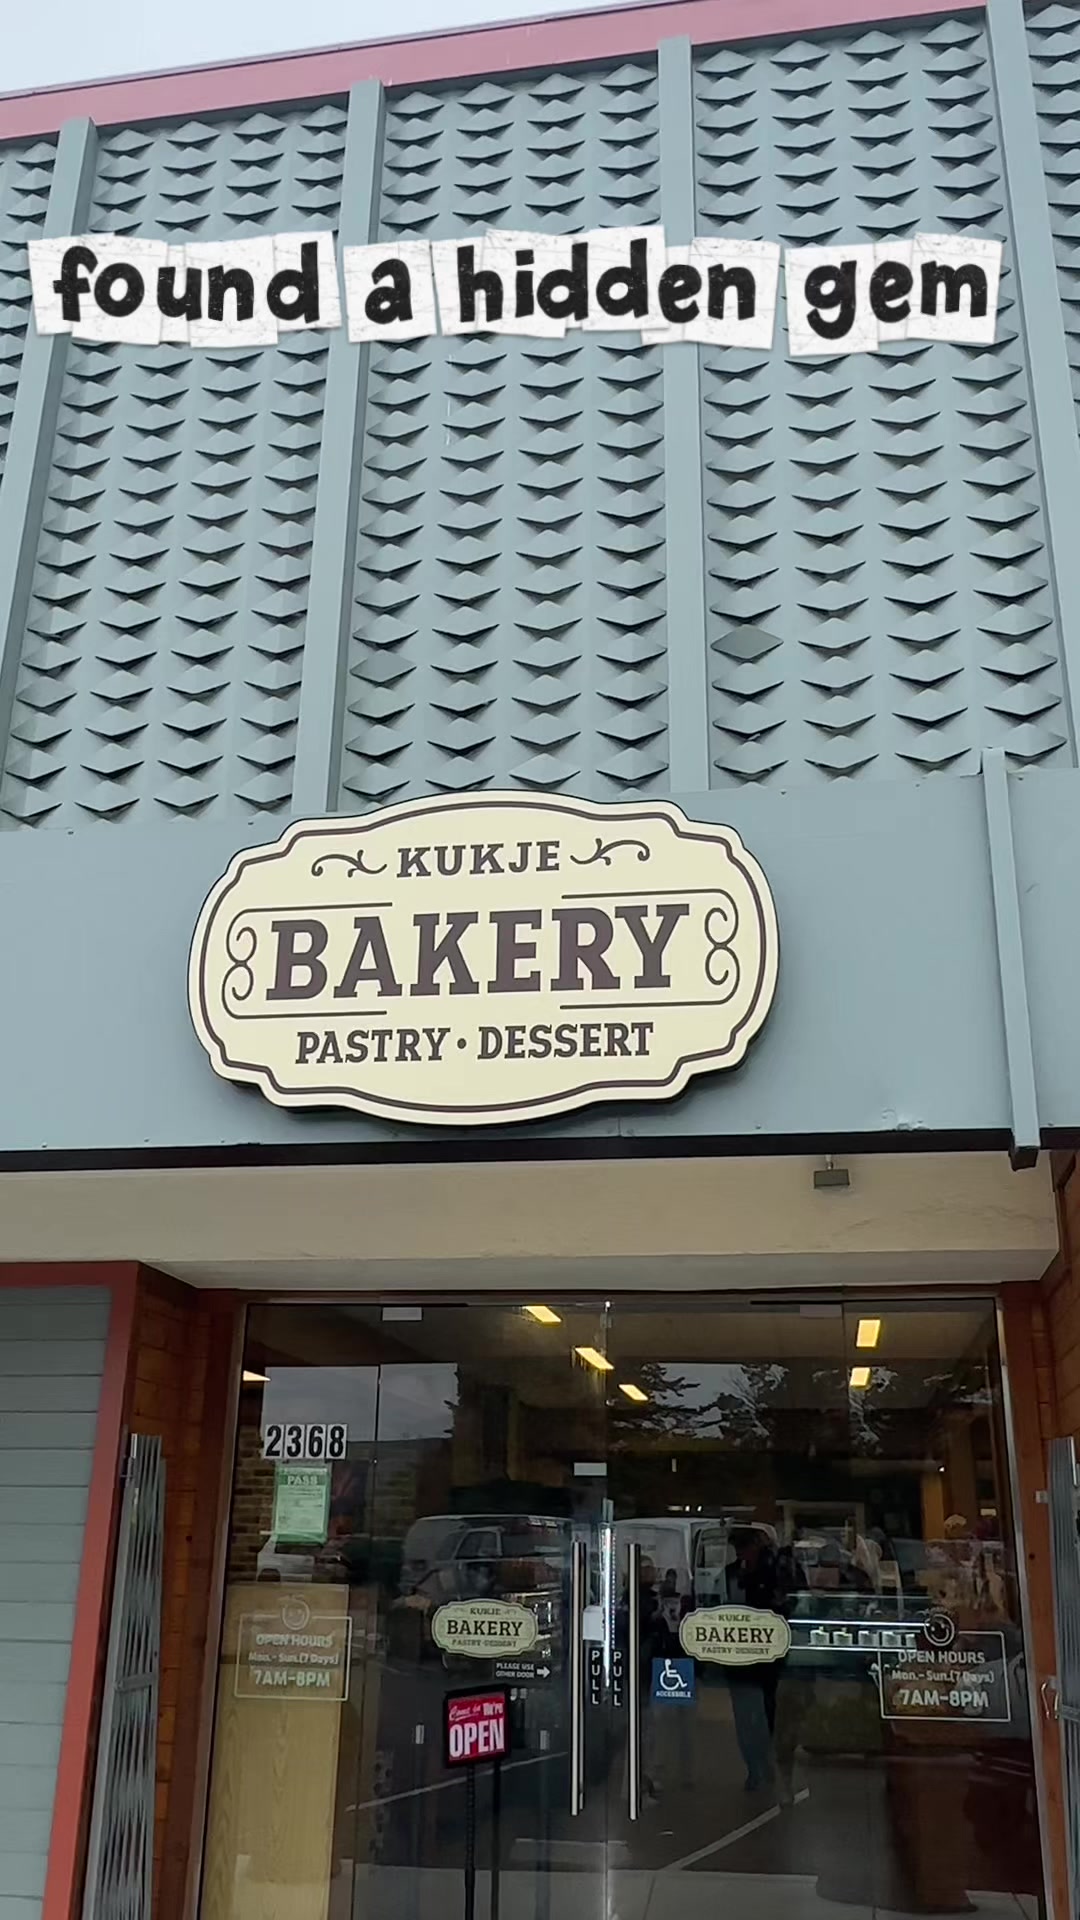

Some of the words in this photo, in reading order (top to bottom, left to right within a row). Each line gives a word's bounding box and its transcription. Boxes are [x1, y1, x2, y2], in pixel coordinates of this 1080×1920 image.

[396, 840, 560, 878] KUKJE
[265, 903, 690, 1000] BAKERY
[295, 1027, 451, 1064] PASTRY
[477, 1021, 654, 1060] DESSERT
[265, 1425, 345, 1458] 2368
[286, 1474, 318, 1486] PASS
[447, 1620, 523, 1636] BAKERY
[695, 1627, 775, 1643] BAKERY
[256, 1634, 290, 1646] OPEN
[291, 1634, 333, 1648] HOURS
[898, 1651, 935, 1663] OPEN
[938, 1651, 985, 1664] HOURS
[496, 1662, 520, 1670] PLEASE
[521, 1663, 535, 1671] USE
[516, 1670, 535, 1679] DOOR
[254, 1670, 331, 1687] 7AM-8PM
[591, 1650, 601, 1705] PULL
[613, 1651, 622, 1706] PULL
[655, 1690, 692, 1698] ACCESSIBLE
[899, 1689, 989, 1708] 7AM-8PM
[449, 1718, 505, 1758] OPEN
